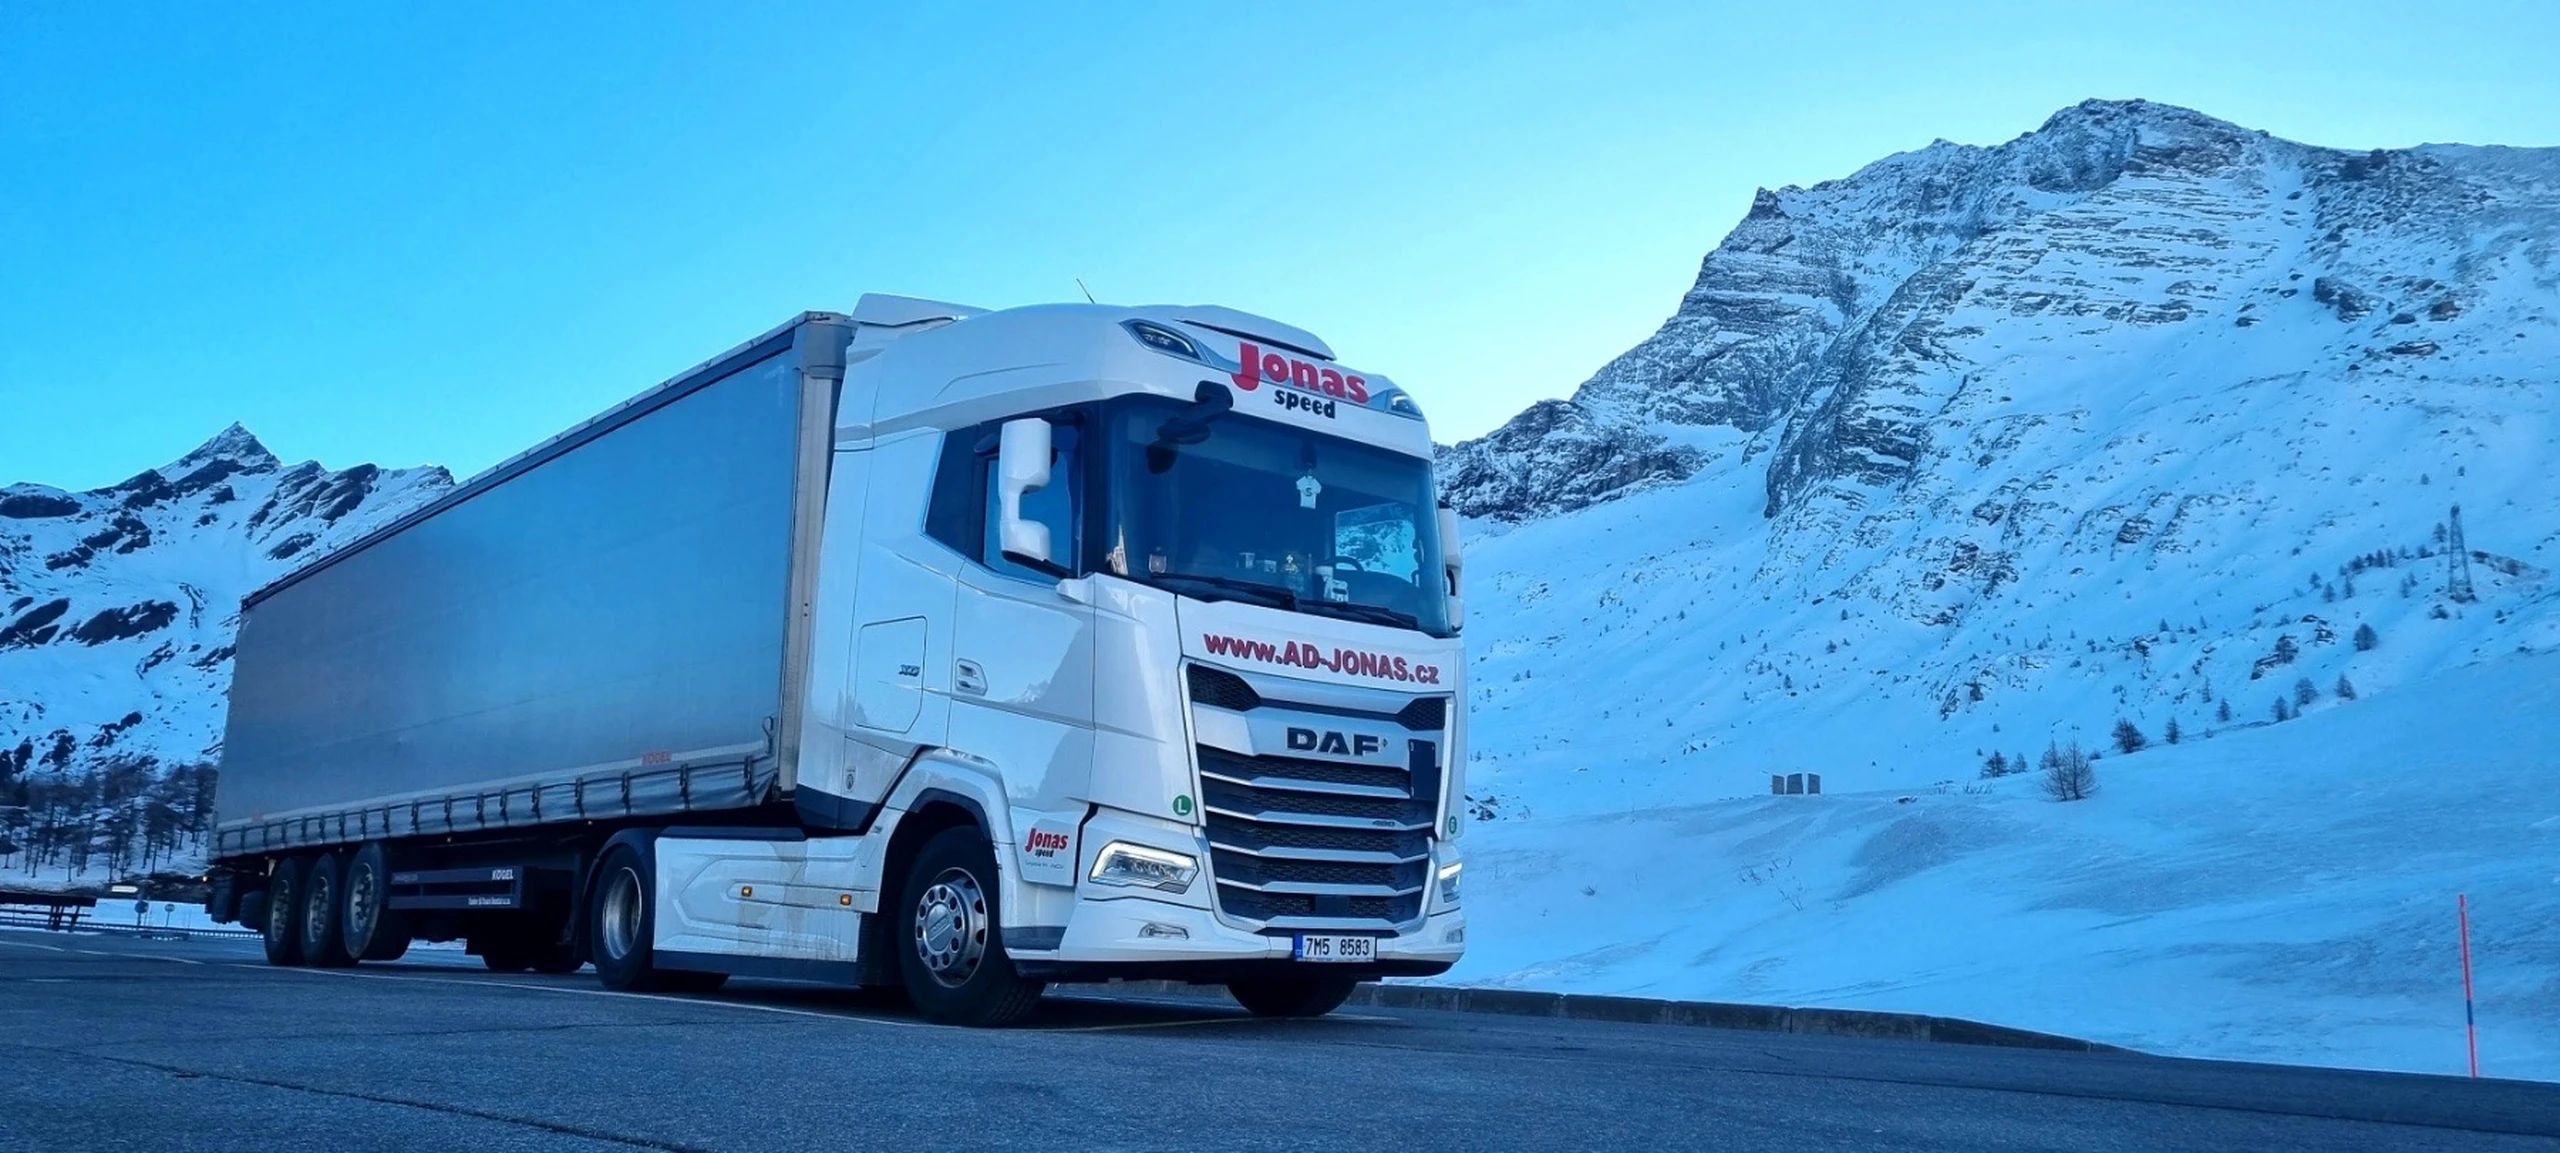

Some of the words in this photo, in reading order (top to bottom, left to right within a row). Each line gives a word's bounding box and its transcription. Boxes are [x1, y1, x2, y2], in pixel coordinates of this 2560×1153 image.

[1230, 341, 1370, 404] Jonas
[1274, 389, 1336, 419] speed
[1203, 633, 1440, 685] www.AD-JONAS.cz
[1286, 727, 1379, 757] DAF
[1178, 798, 1187, 813] L
[1024, 827, 1069, 853] Jonas
[1305, 937, 1330, 956] 7M5
[1339, 938, 1370, 956] 8583
